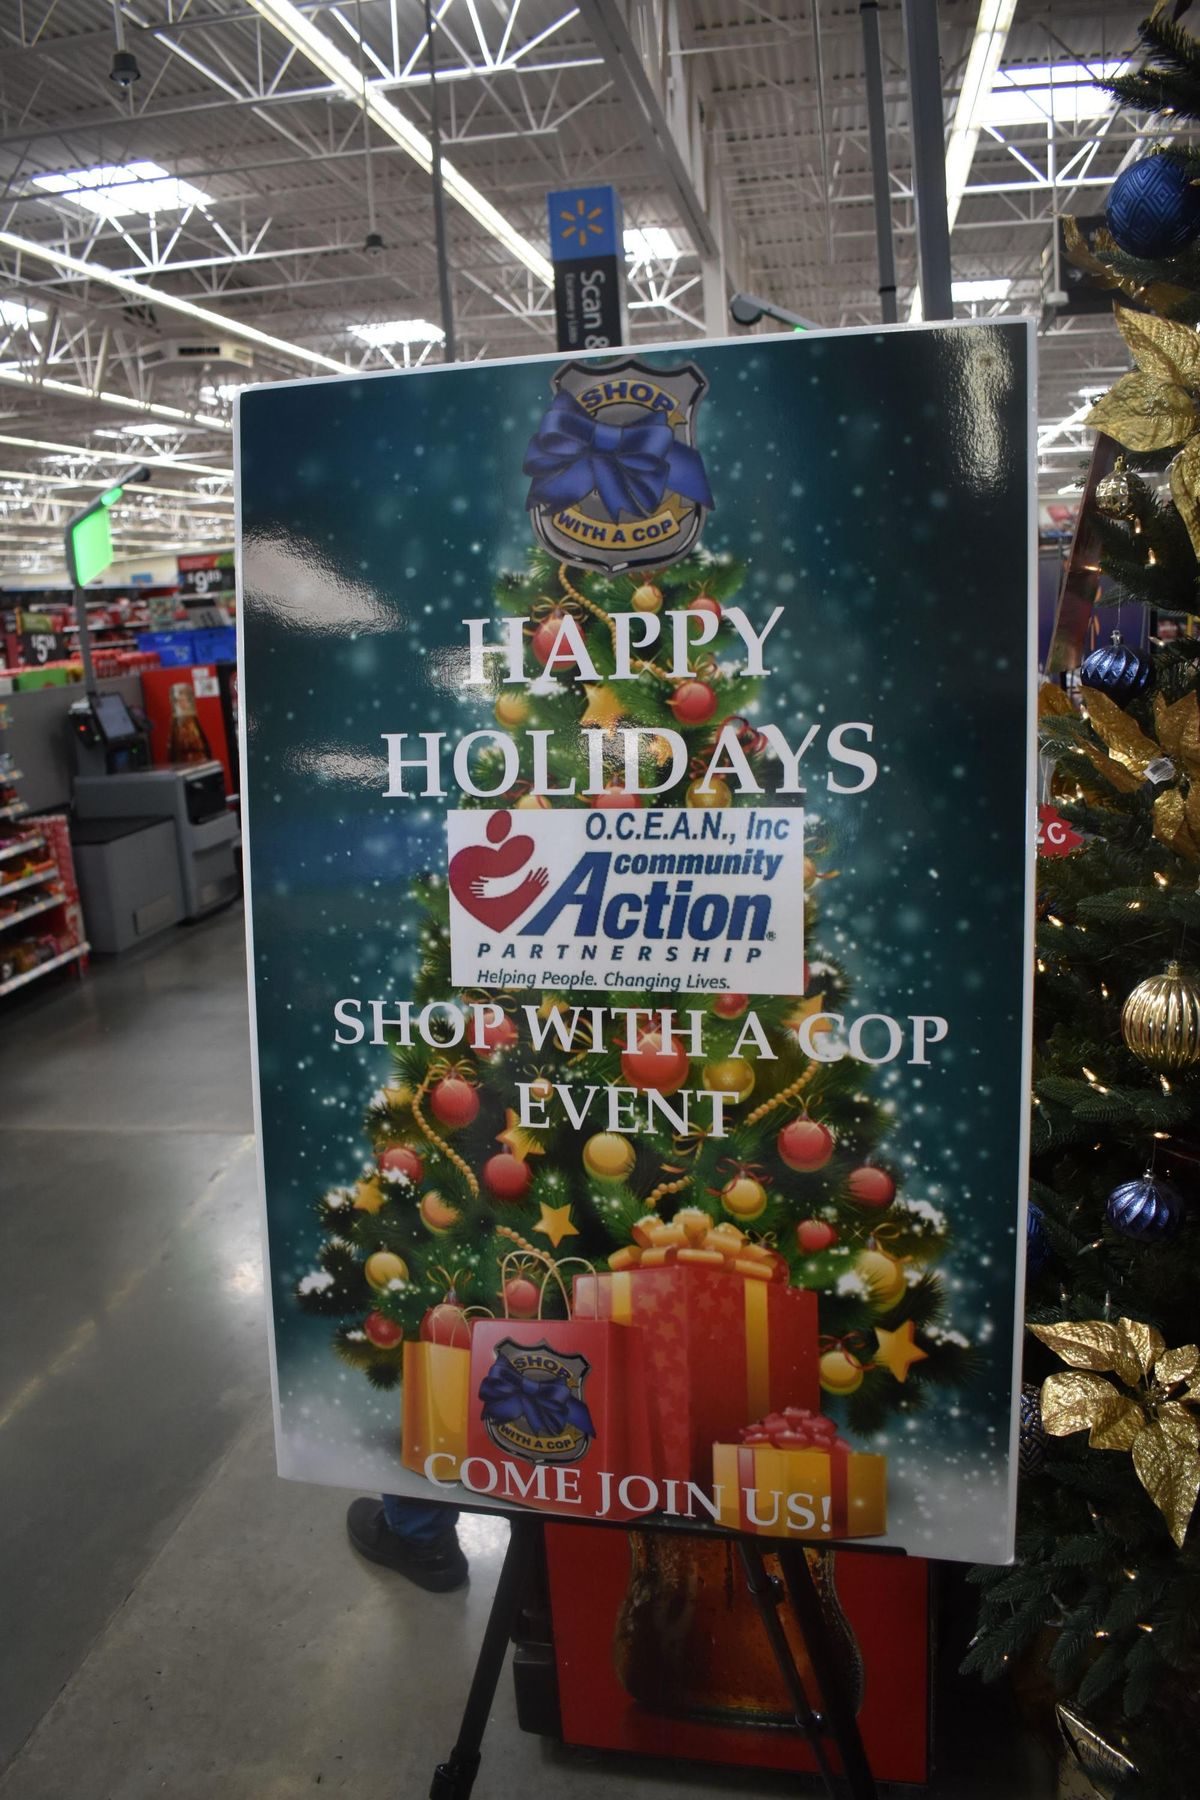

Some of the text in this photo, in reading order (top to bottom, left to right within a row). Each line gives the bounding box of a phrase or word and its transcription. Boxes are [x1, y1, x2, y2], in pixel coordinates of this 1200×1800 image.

[580, 270, 609, 350] Scan &
[582, 381, 675, 412] SHOP
[558, 511, 673, 543] WITH A COP
[462, 606, 785, 686] HAPPY
[380, 722, 879, 799] HOLIDAYS
[585, 811, 790, 844] O.C.E.A.N., Inc
[613, 848, 784, 881] community
[516, 851, 773, 941] Action
[477, 942, 763, 963] PARTNERSHIP
[477, 969, 731, 993] Helping People. Changing Lives.
[334, 998, 949, 1066] SHOP WITH A COP
[514, 1081, 740, 1139] EVENT
[513, 1356, 571, 1379] SHOP
[502, 1425, 572, 1450] WITH A COP
[423, 1452, 832, 1533] COME JOIN US!
